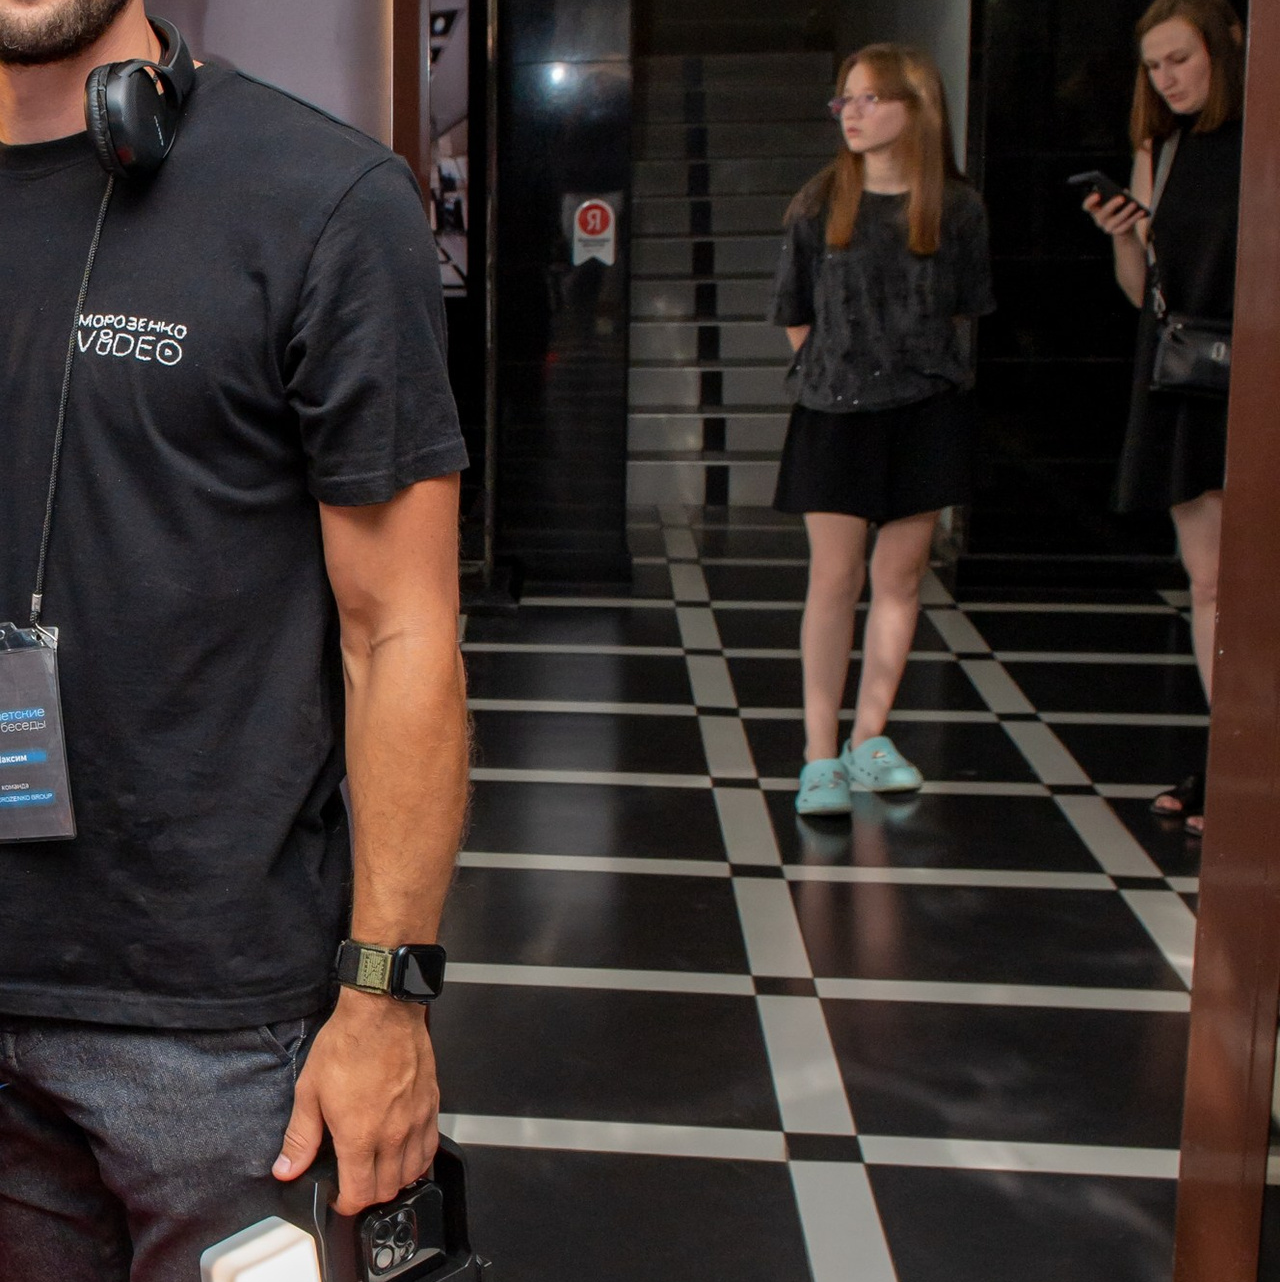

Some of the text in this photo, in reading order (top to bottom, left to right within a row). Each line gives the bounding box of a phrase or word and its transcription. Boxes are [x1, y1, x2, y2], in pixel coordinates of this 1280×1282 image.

[78, 313, 188, 340] МОРОЗЕНКО
[0, 720, 47, 733] беседы
[1, 783, 30, 791] команда
